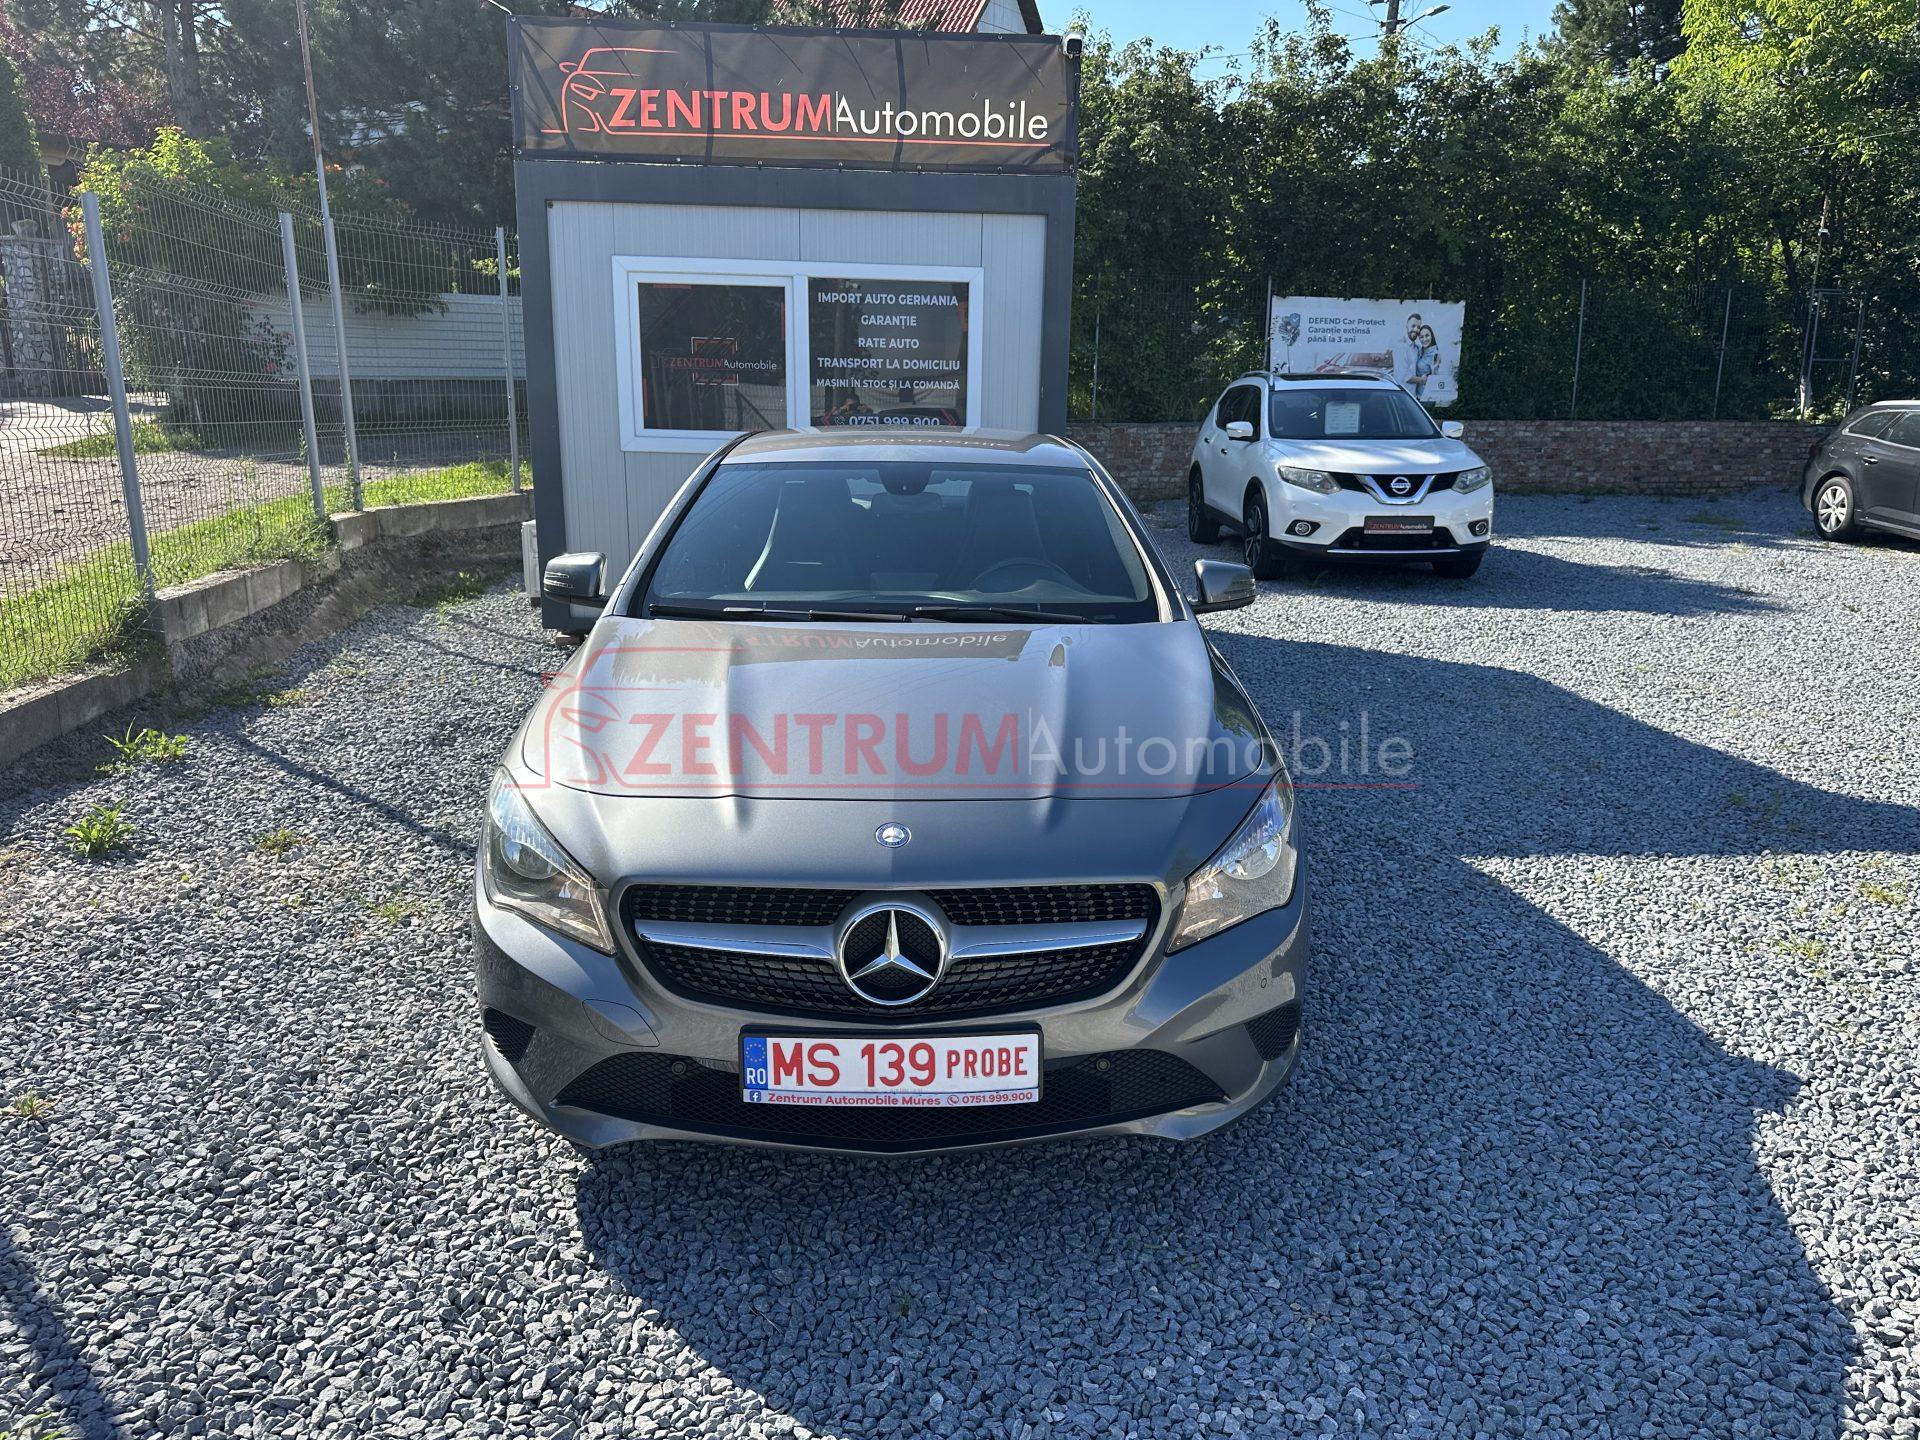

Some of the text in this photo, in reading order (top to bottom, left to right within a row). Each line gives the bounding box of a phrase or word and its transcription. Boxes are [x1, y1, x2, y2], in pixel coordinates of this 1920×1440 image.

[609, 88, 1048, 140] ZENTRUM Automobile
[818, 292, 958, 306] IMPORT AUTO GERMANIA
[861, 315, 917, 329] GARANȚIE
[1308, 317, 1340, 325] DEFEND
[858, 337, 919, 349] RATE AUTO
[723, 359, 777, 370] Automobile
[817, 357, 960, 370] TRANSPORT LA DOMICILIU
[816, 377, 960, 391] MAȘINI ÎN STOC ȘI LA COMANDĂ
[772, 1042, 1028, 1088] MS 139 PROBE
[747, 1068, 766, 1085] RO
[768, 1093, 822, 1104] Zentrum
[825, 1095, 899, 1105] Automobile
[962, 1092, 1033, 1104] 0751.999.900
